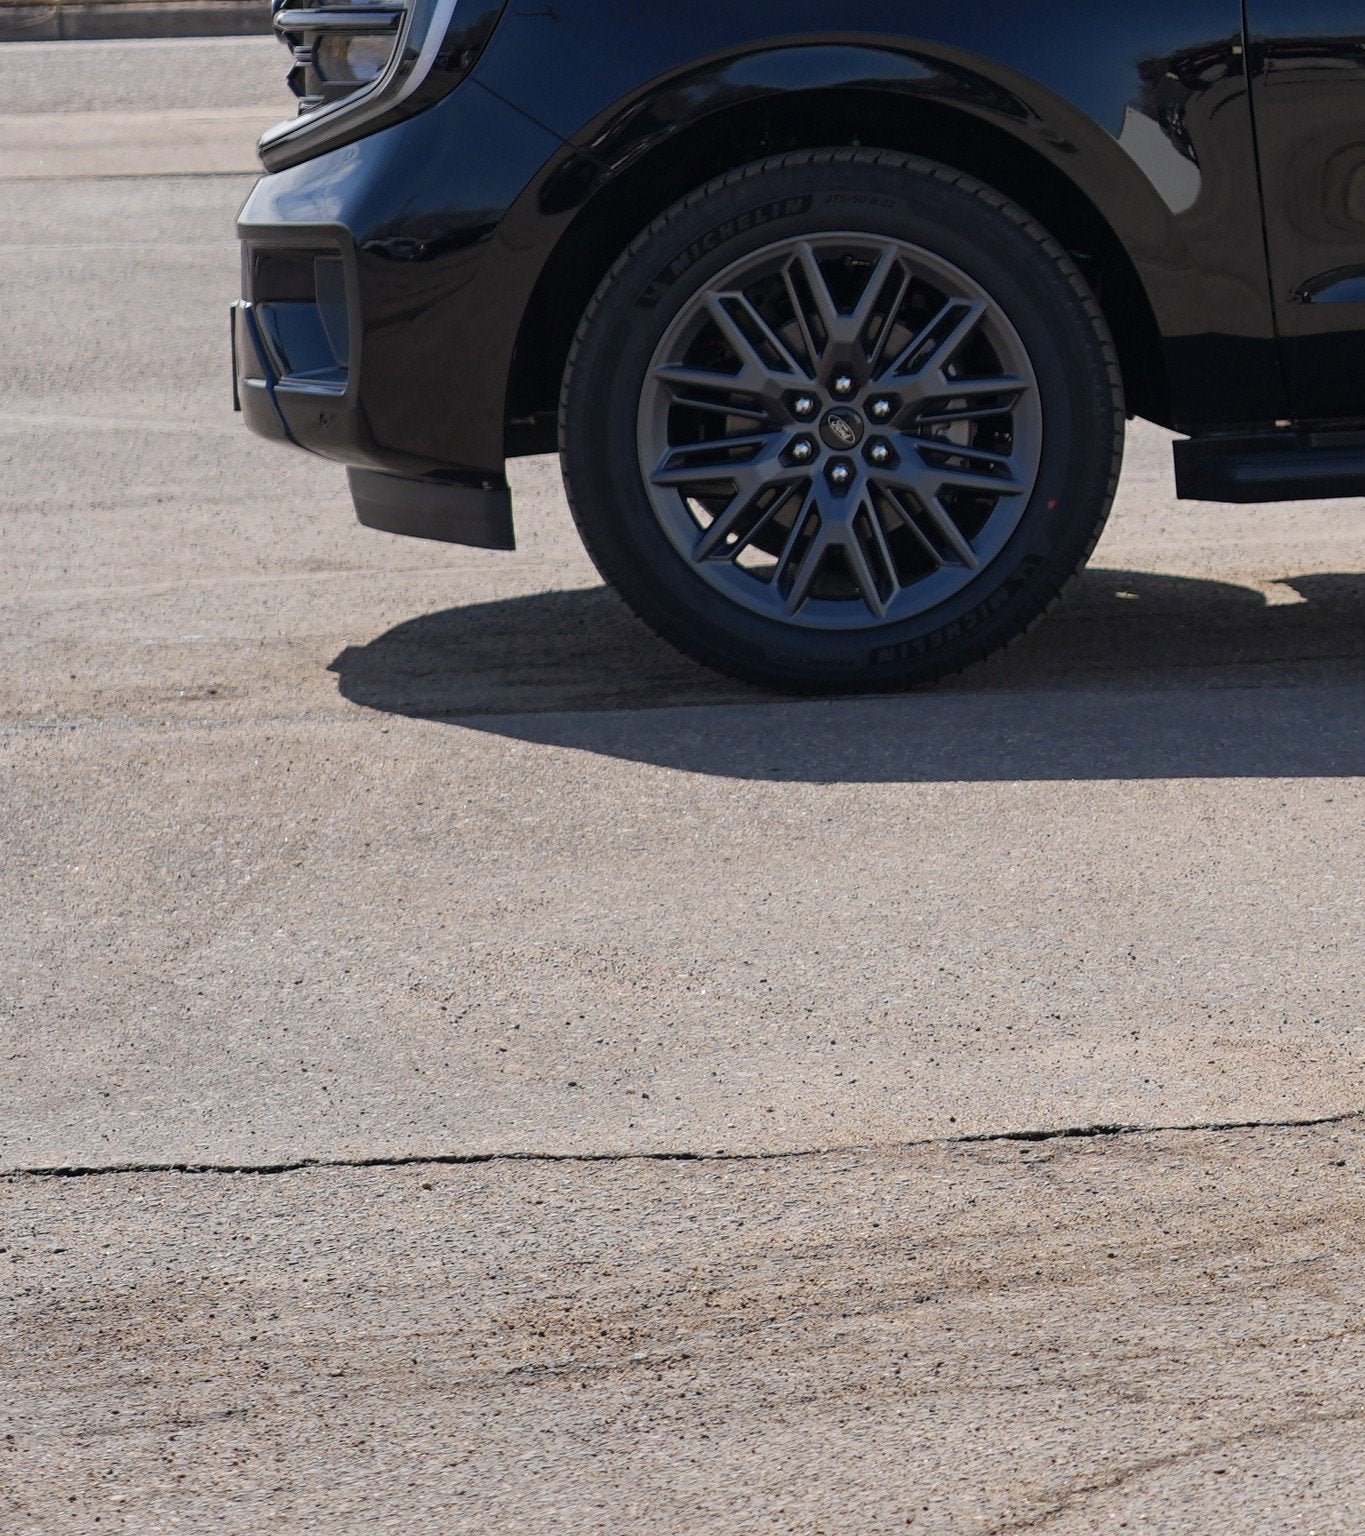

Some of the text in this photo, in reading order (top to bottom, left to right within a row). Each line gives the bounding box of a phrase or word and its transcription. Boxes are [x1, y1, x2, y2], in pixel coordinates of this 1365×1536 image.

[671, 197, 804, 277] MICHELIN
[830, 417, 853, 442] Ford
[876, 589, 1010, 664] MICHELIN
